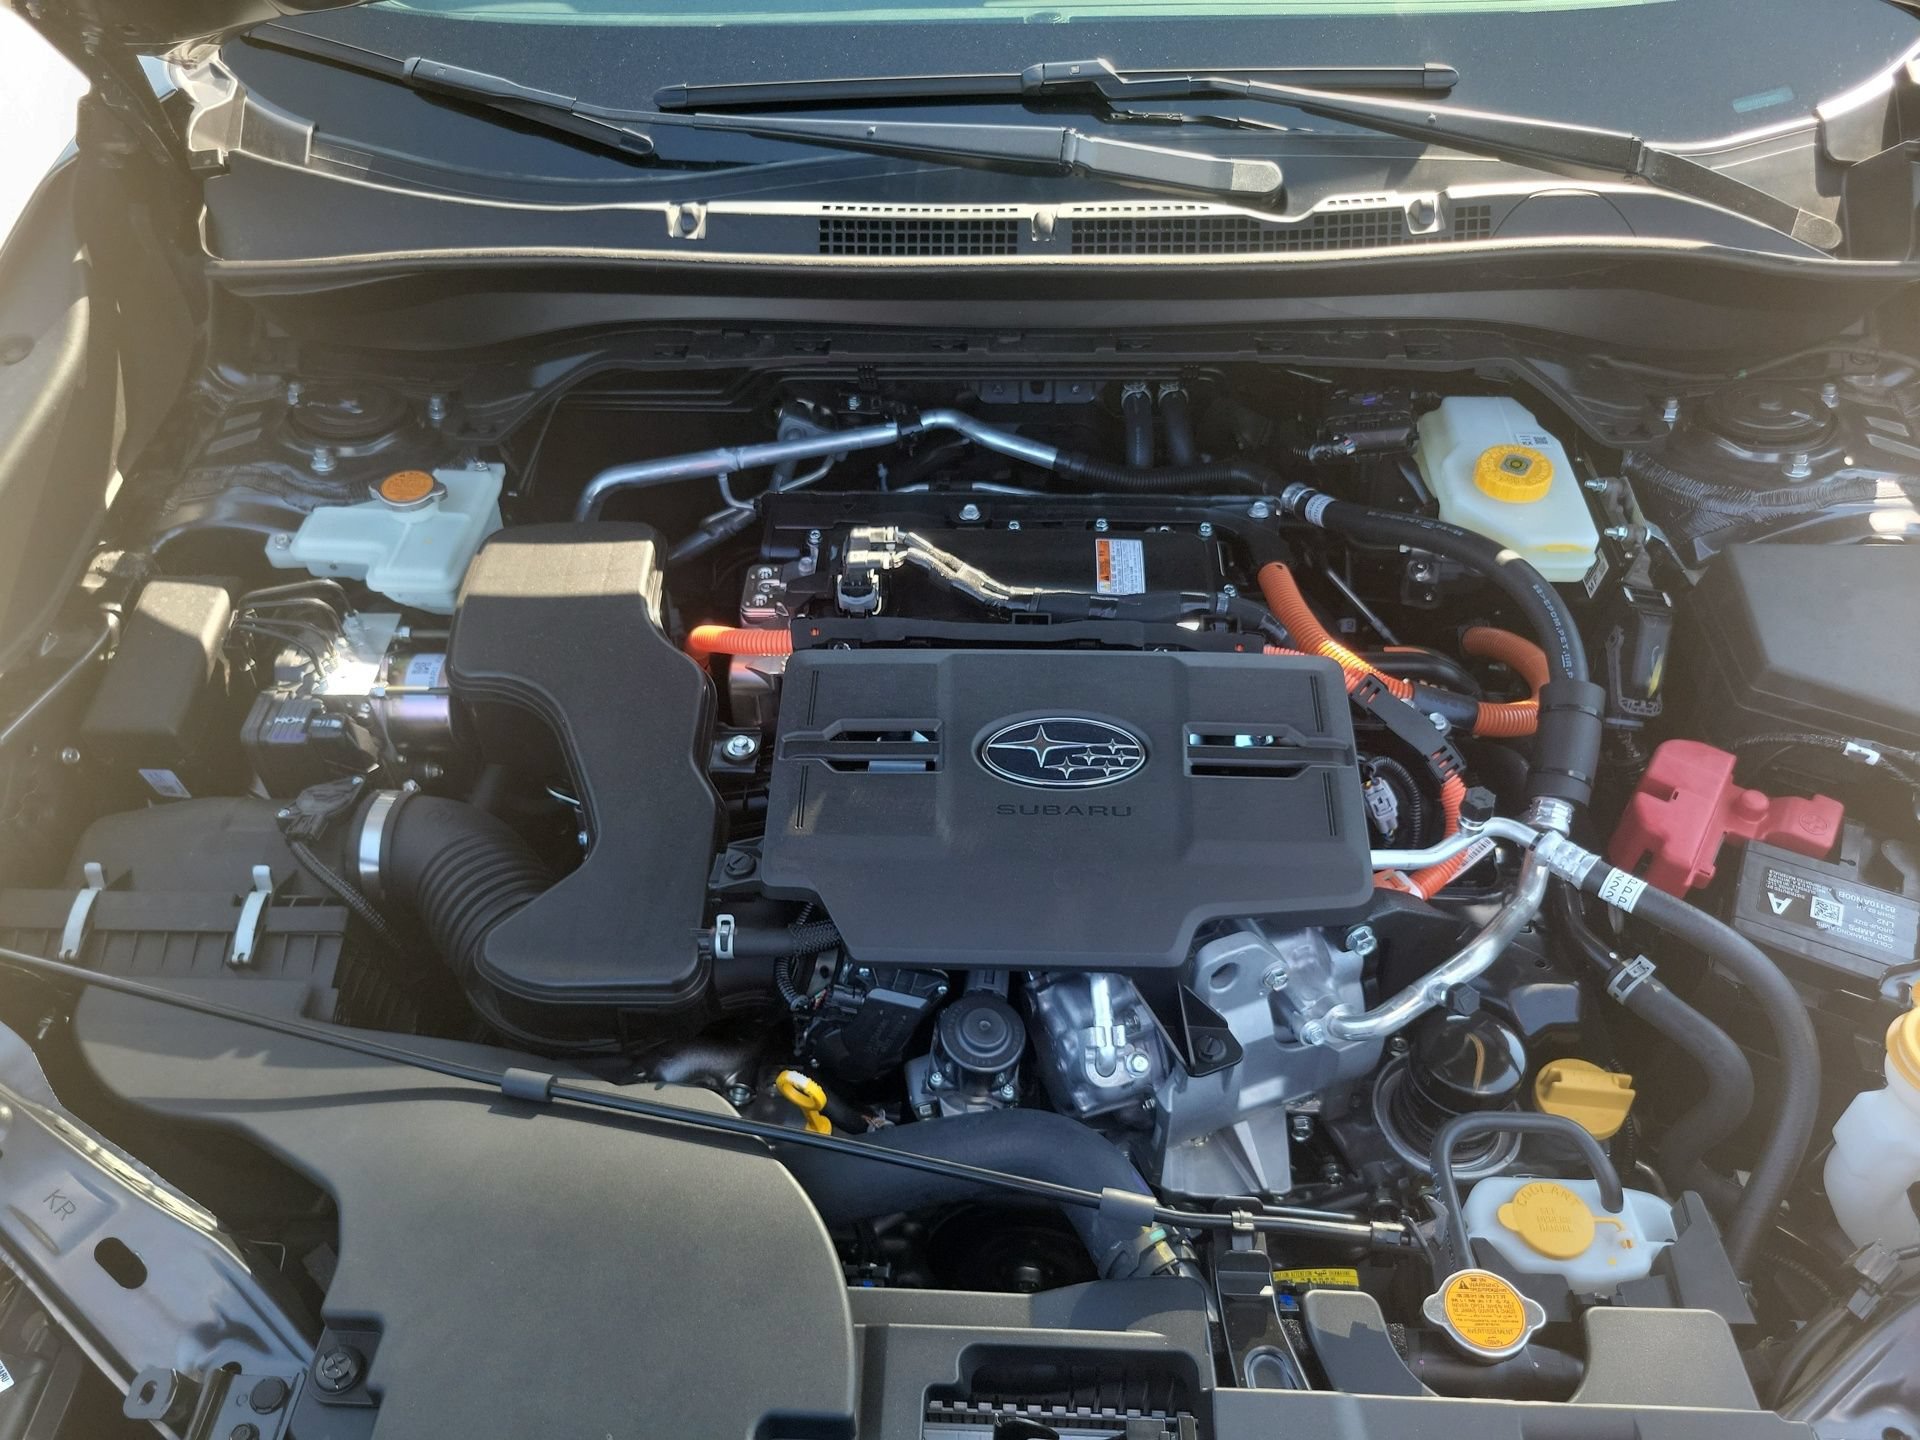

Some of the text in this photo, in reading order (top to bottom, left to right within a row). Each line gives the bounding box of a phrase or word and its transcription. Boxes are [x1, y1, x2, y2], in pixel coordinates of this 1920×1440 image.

[996, 804, 1132, 817] SUBARU
[1767, 892, 1792, 915] A
[1815, 920, 1893, 949] COLD CRANKING AMPS
[1847, 923, 1875, 937] AMPS
[42, 1189, 76, 1221] KR
[1516, 1183, 1580, 1207] COOLANT
